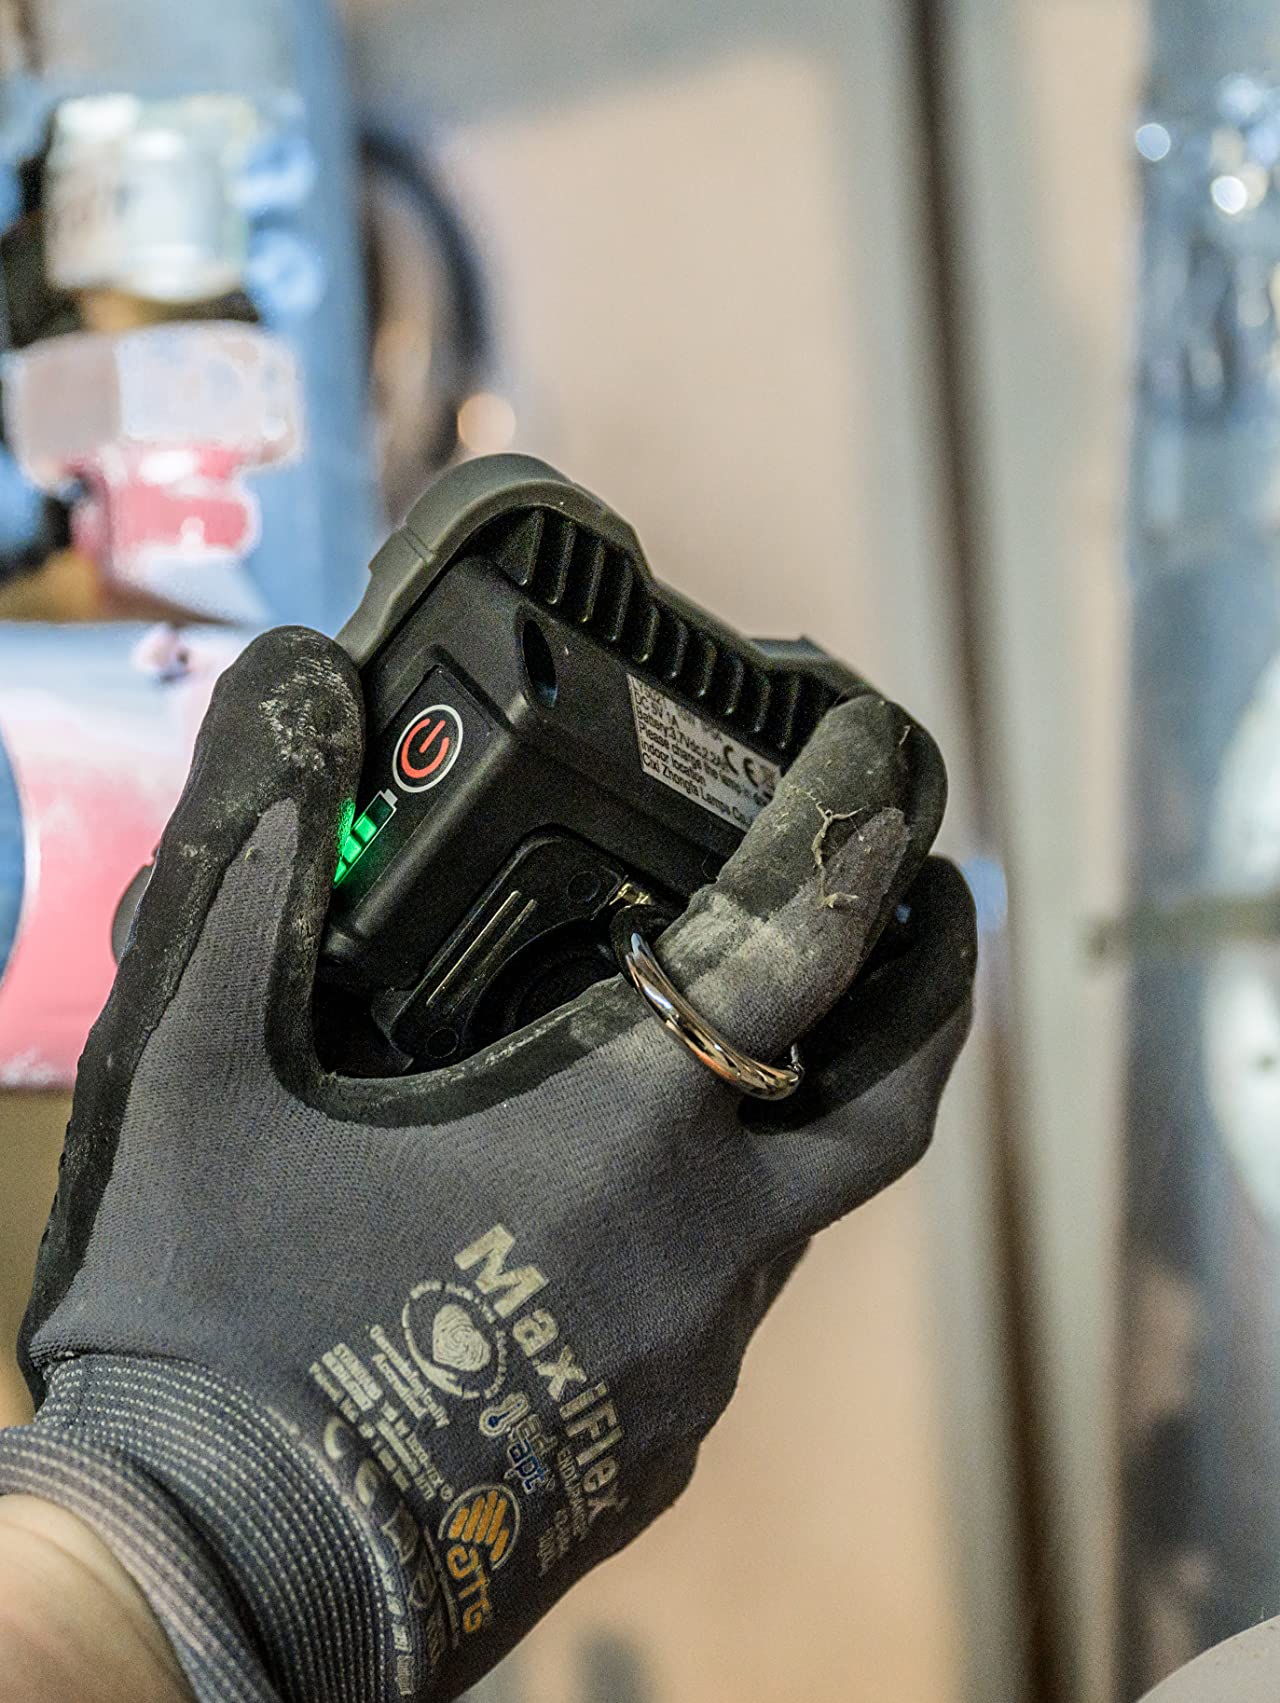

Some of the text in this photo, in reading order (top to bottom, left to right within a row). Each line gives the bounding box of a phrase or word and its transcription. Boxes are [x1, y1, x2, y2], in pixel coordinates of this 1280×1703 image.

[638, 719, 670, 751] Please
[671, 742, 702, 771] charge
[640, 735, 705, 786] indoor location
[372, 1351, 426, 1417] Accredited
[453, 1222, 628, 1527] MaxiFlex
